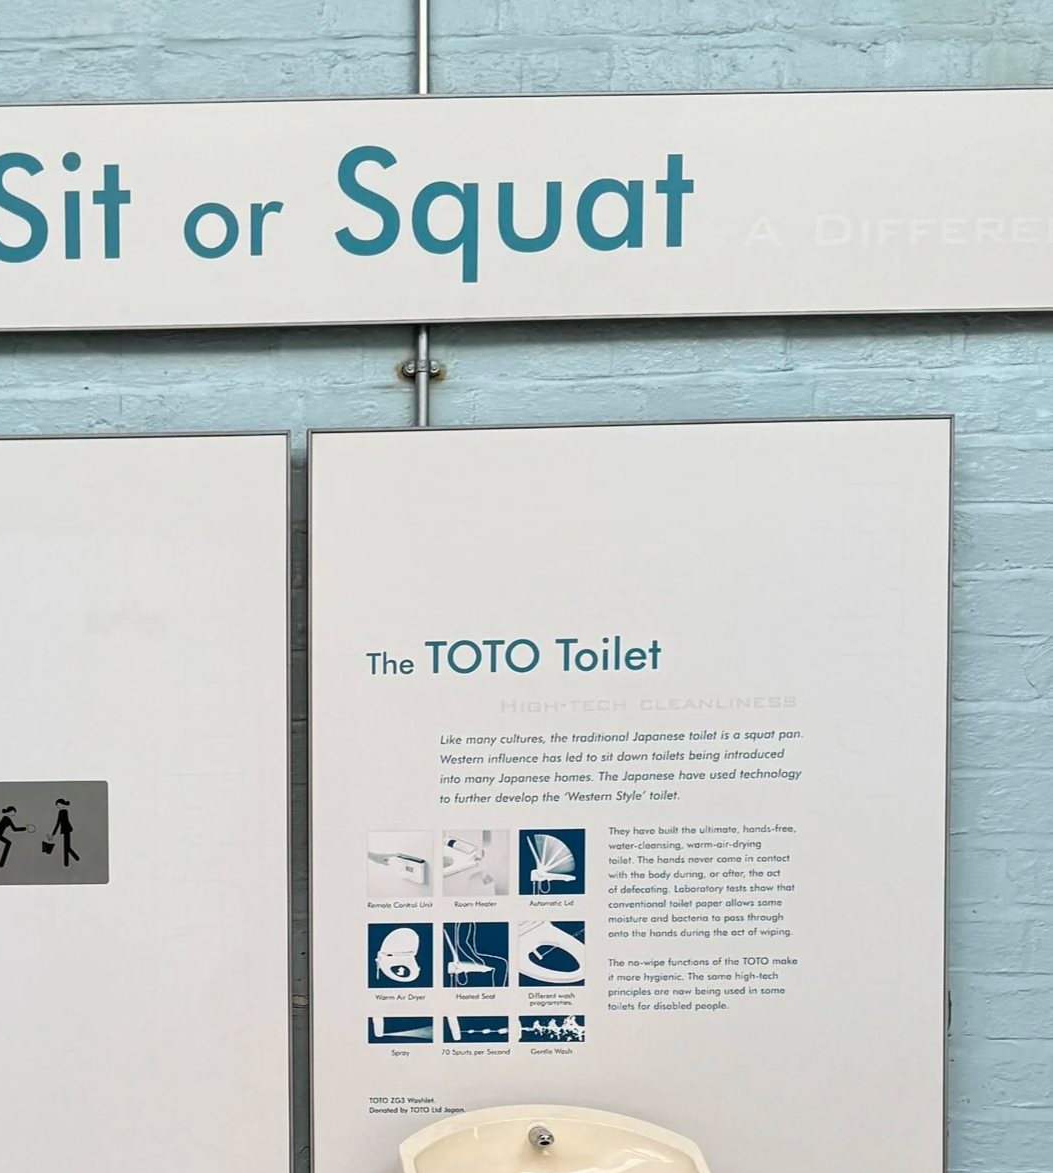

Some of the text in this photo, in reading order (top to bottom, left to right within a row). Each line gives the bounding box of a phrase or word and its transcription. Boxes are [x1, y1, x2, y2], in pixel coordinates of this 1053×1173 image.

[183, 201, 283, 258] or
[335, 147, 694, 280] Squat
[814, 213, 1053, 248] DIFFERE
[365, 637, 661, 674] The TOTO Toilet
[639, 696, 798, 712] CLEANLINESS
[439, 734, 462, 744] Like
[465, 736, 497, 746] many
[499, 733, 545, 744] cultures,
[550, 732, 568, 742] the
[571, 731, 629, 742] traditional
[631, 731, 685, 743] Japanese
[688, 729, 717, 740] toilet
[720, 730, 729, 740] is
[743, 730, 775, 741] squat
[778, 731, 803, 741] pan.
[439, 748, 785, 764] Western influence has led to sit down toilets being introduced
[439, 768, 802, 785] into many Japanese homes. The Japanese have used technology
[439, 795, 450, 803] to
[454, 792, 491, 803] further
[494, 792, 538, 804] develop
[542, 791, 560, 801] the
[649, 789, 680, 800] toilet.
[607, 956, 798, 968] The no-wipe functions of the TOTO make
[607, 973, 614, 981] it
[687, 972, 704, 980] The
[734, 971, 778, 982] high-tech
